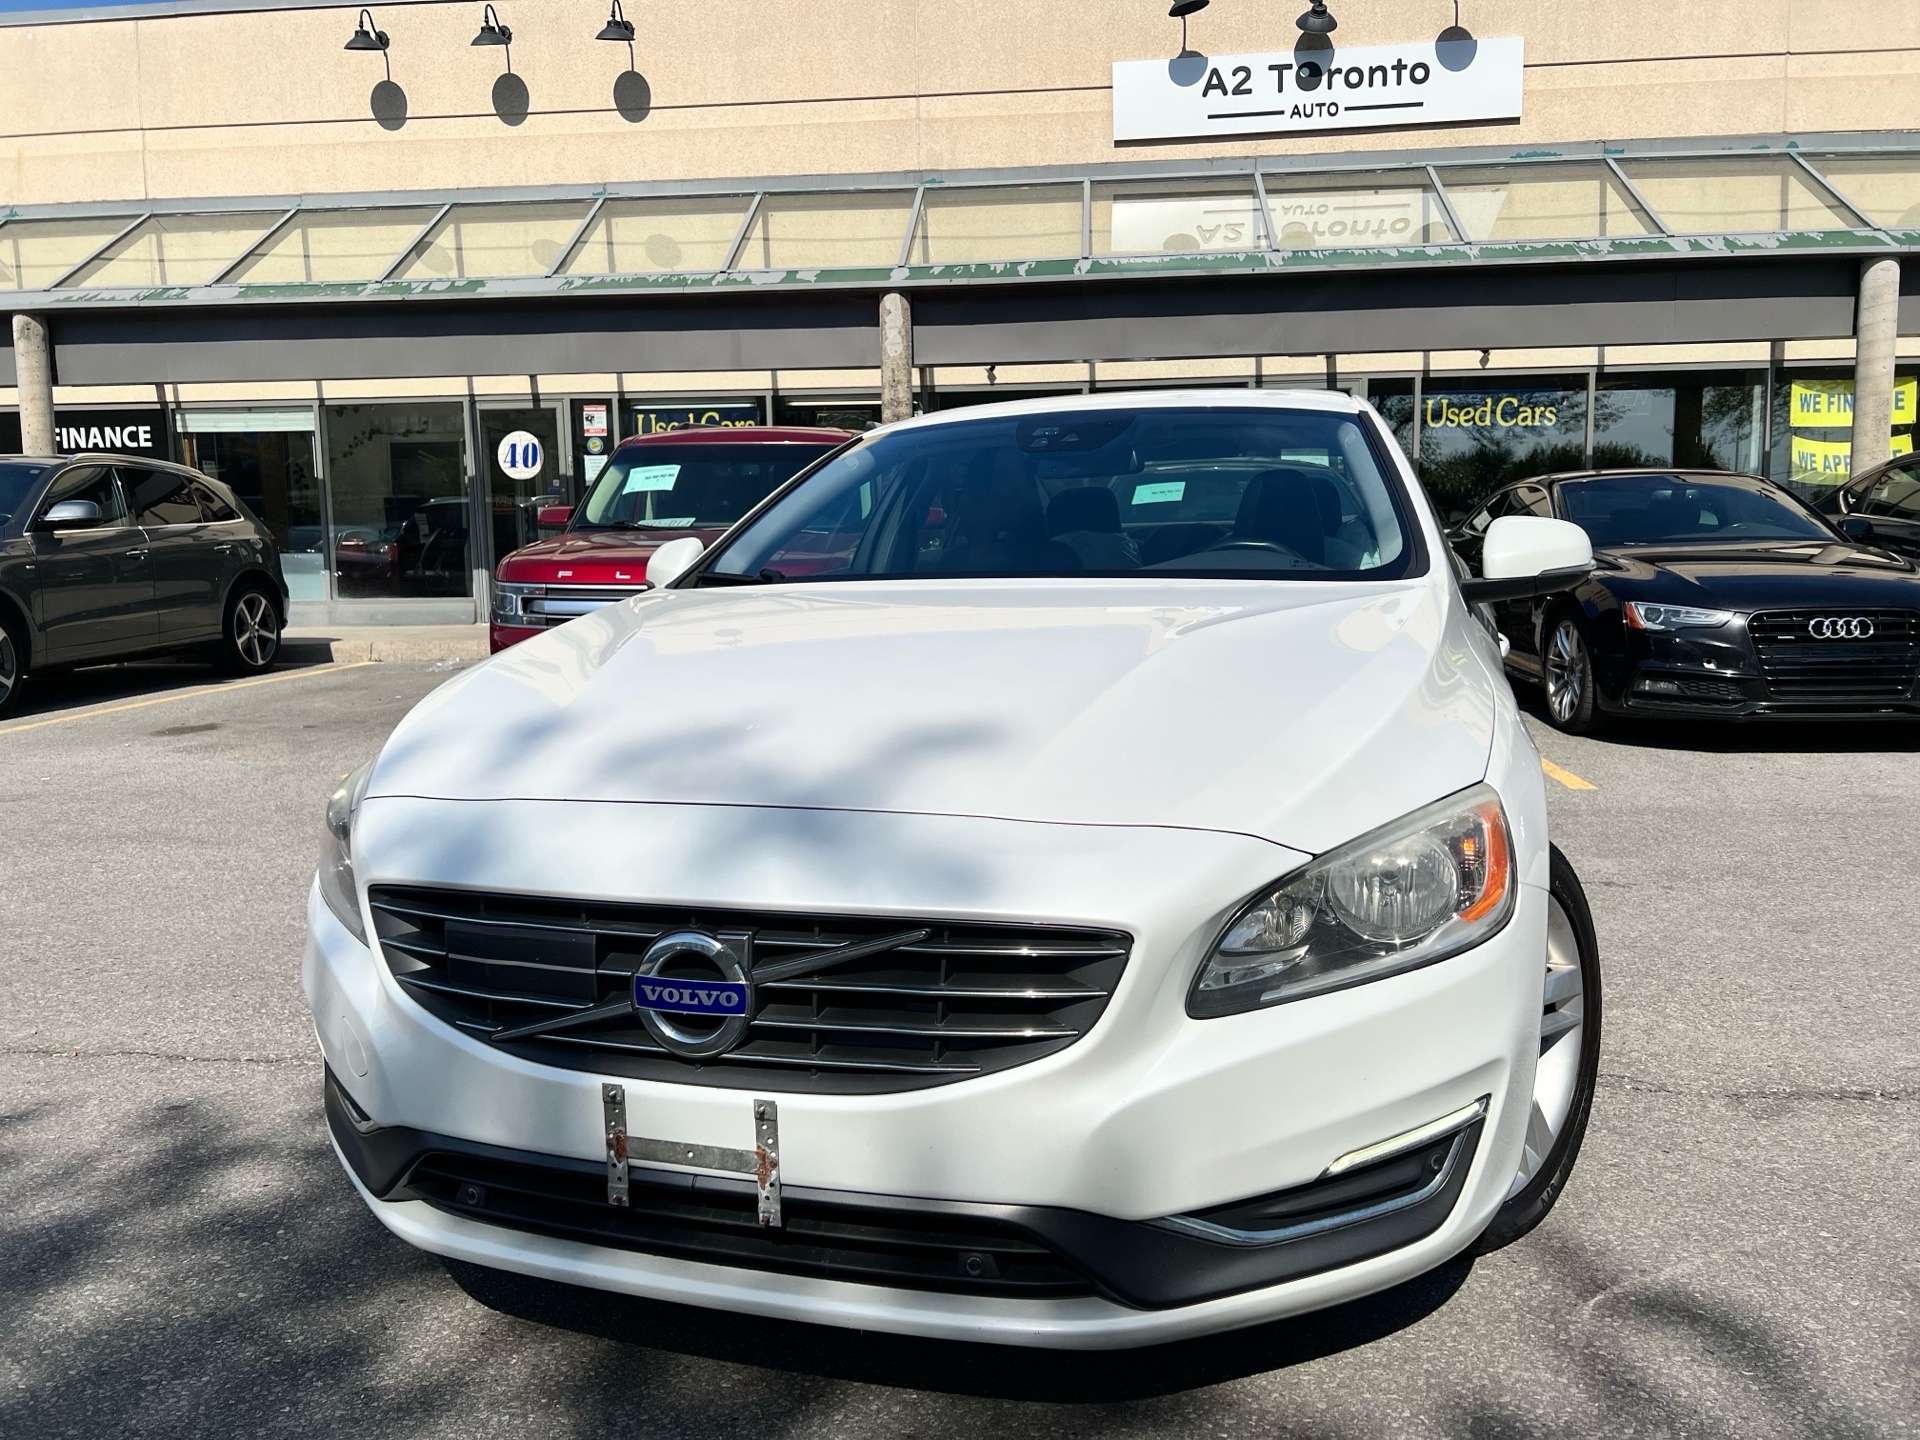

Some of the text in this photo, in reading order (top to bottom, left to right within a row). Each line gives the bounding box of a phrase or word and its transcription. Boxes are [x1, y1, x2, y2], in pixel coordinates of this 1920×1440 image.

[1202, 66, 1253, 98] A2
[1290, 102, 1339, 119] AUTO
[1426, 397, 1557, 428] Used Cars
[1800, 390, 1905, 413] WE FINE
[504, 442, 538, 468] 40
[1798, 450, 1817, 471] WE
[641, 984, 739, 1007] VOLVO
